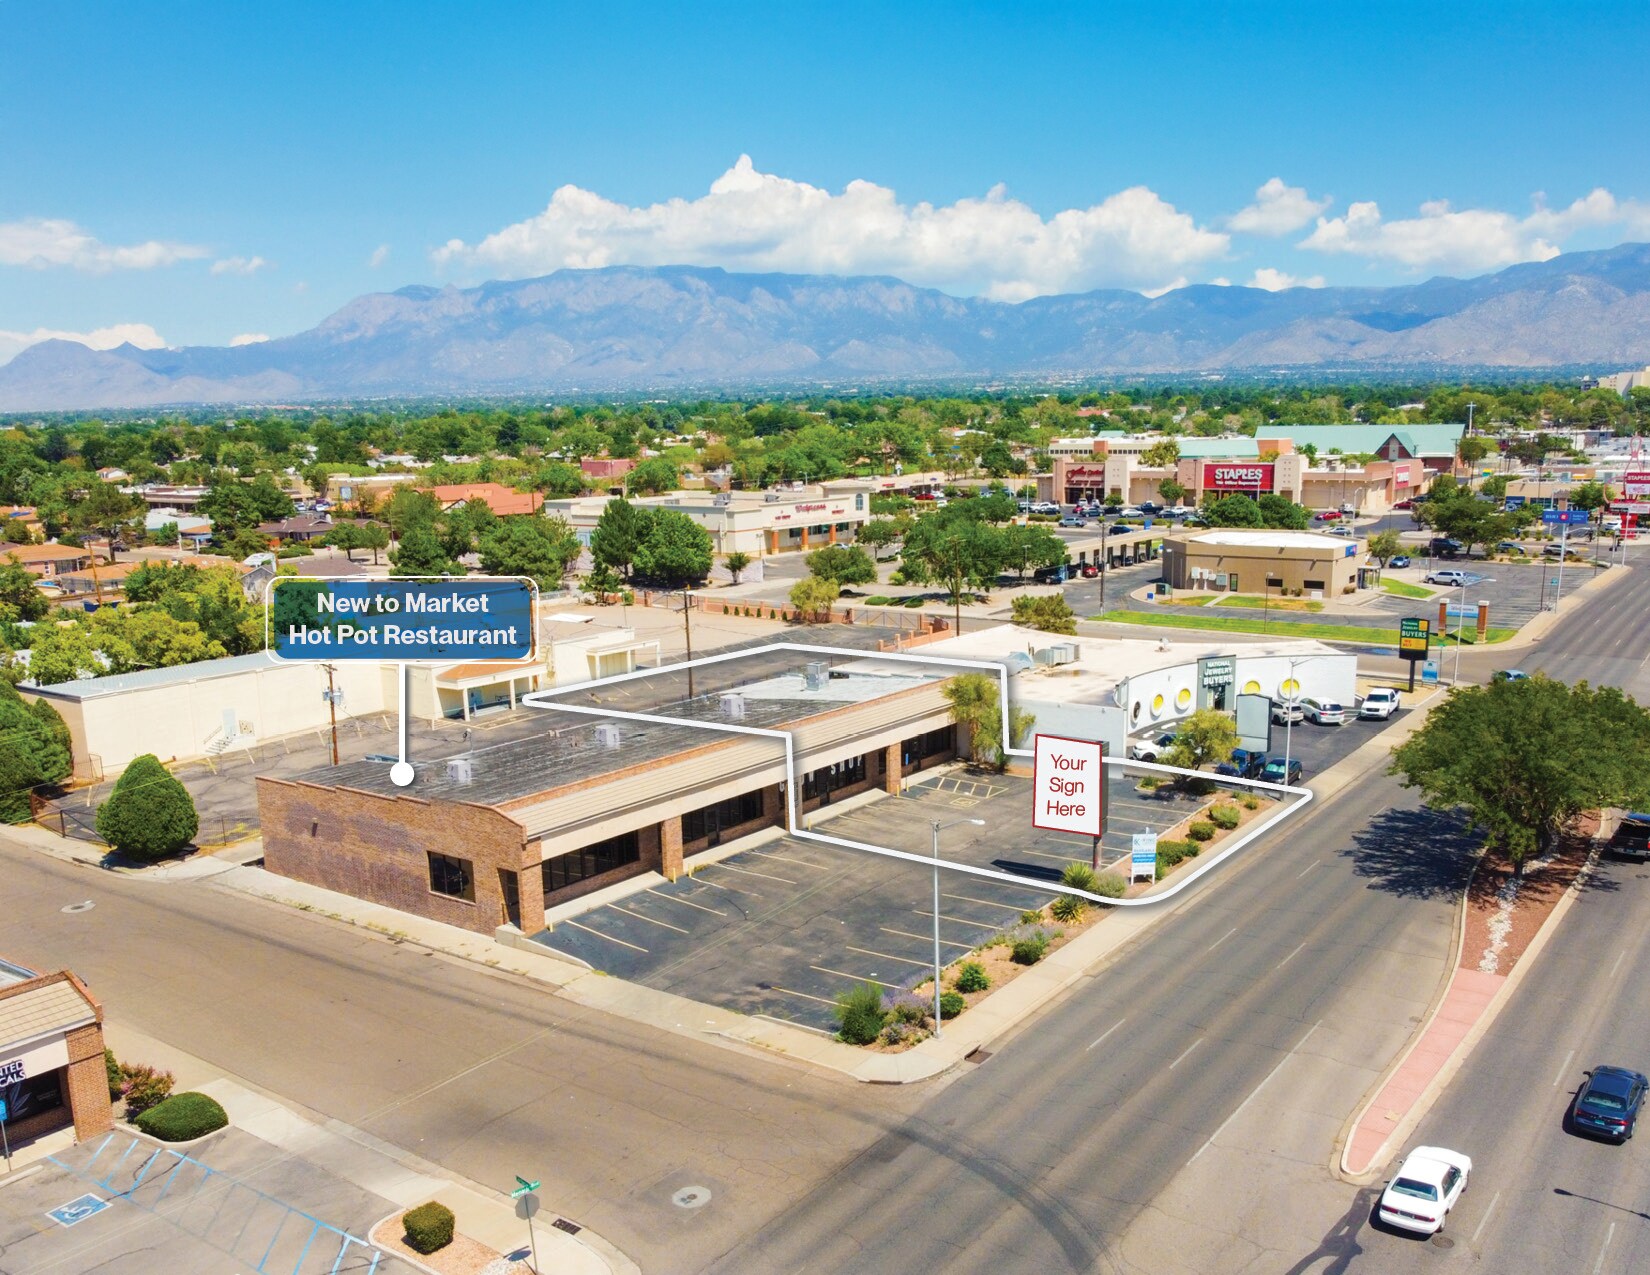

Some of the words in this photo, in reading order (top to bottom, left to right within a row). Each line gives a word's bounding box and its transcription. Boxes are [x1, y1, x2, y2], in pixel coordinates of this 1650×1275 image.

[1215, 468, 1262, 480] STAPLES
[1401, 630, 1427, 638] BUYERS
[1207, 660, 1230, 668] NATIONAL
[1204, 666, 1233, 676] JEWELRY
[1203, 674, 1234, 685] BUYERS
